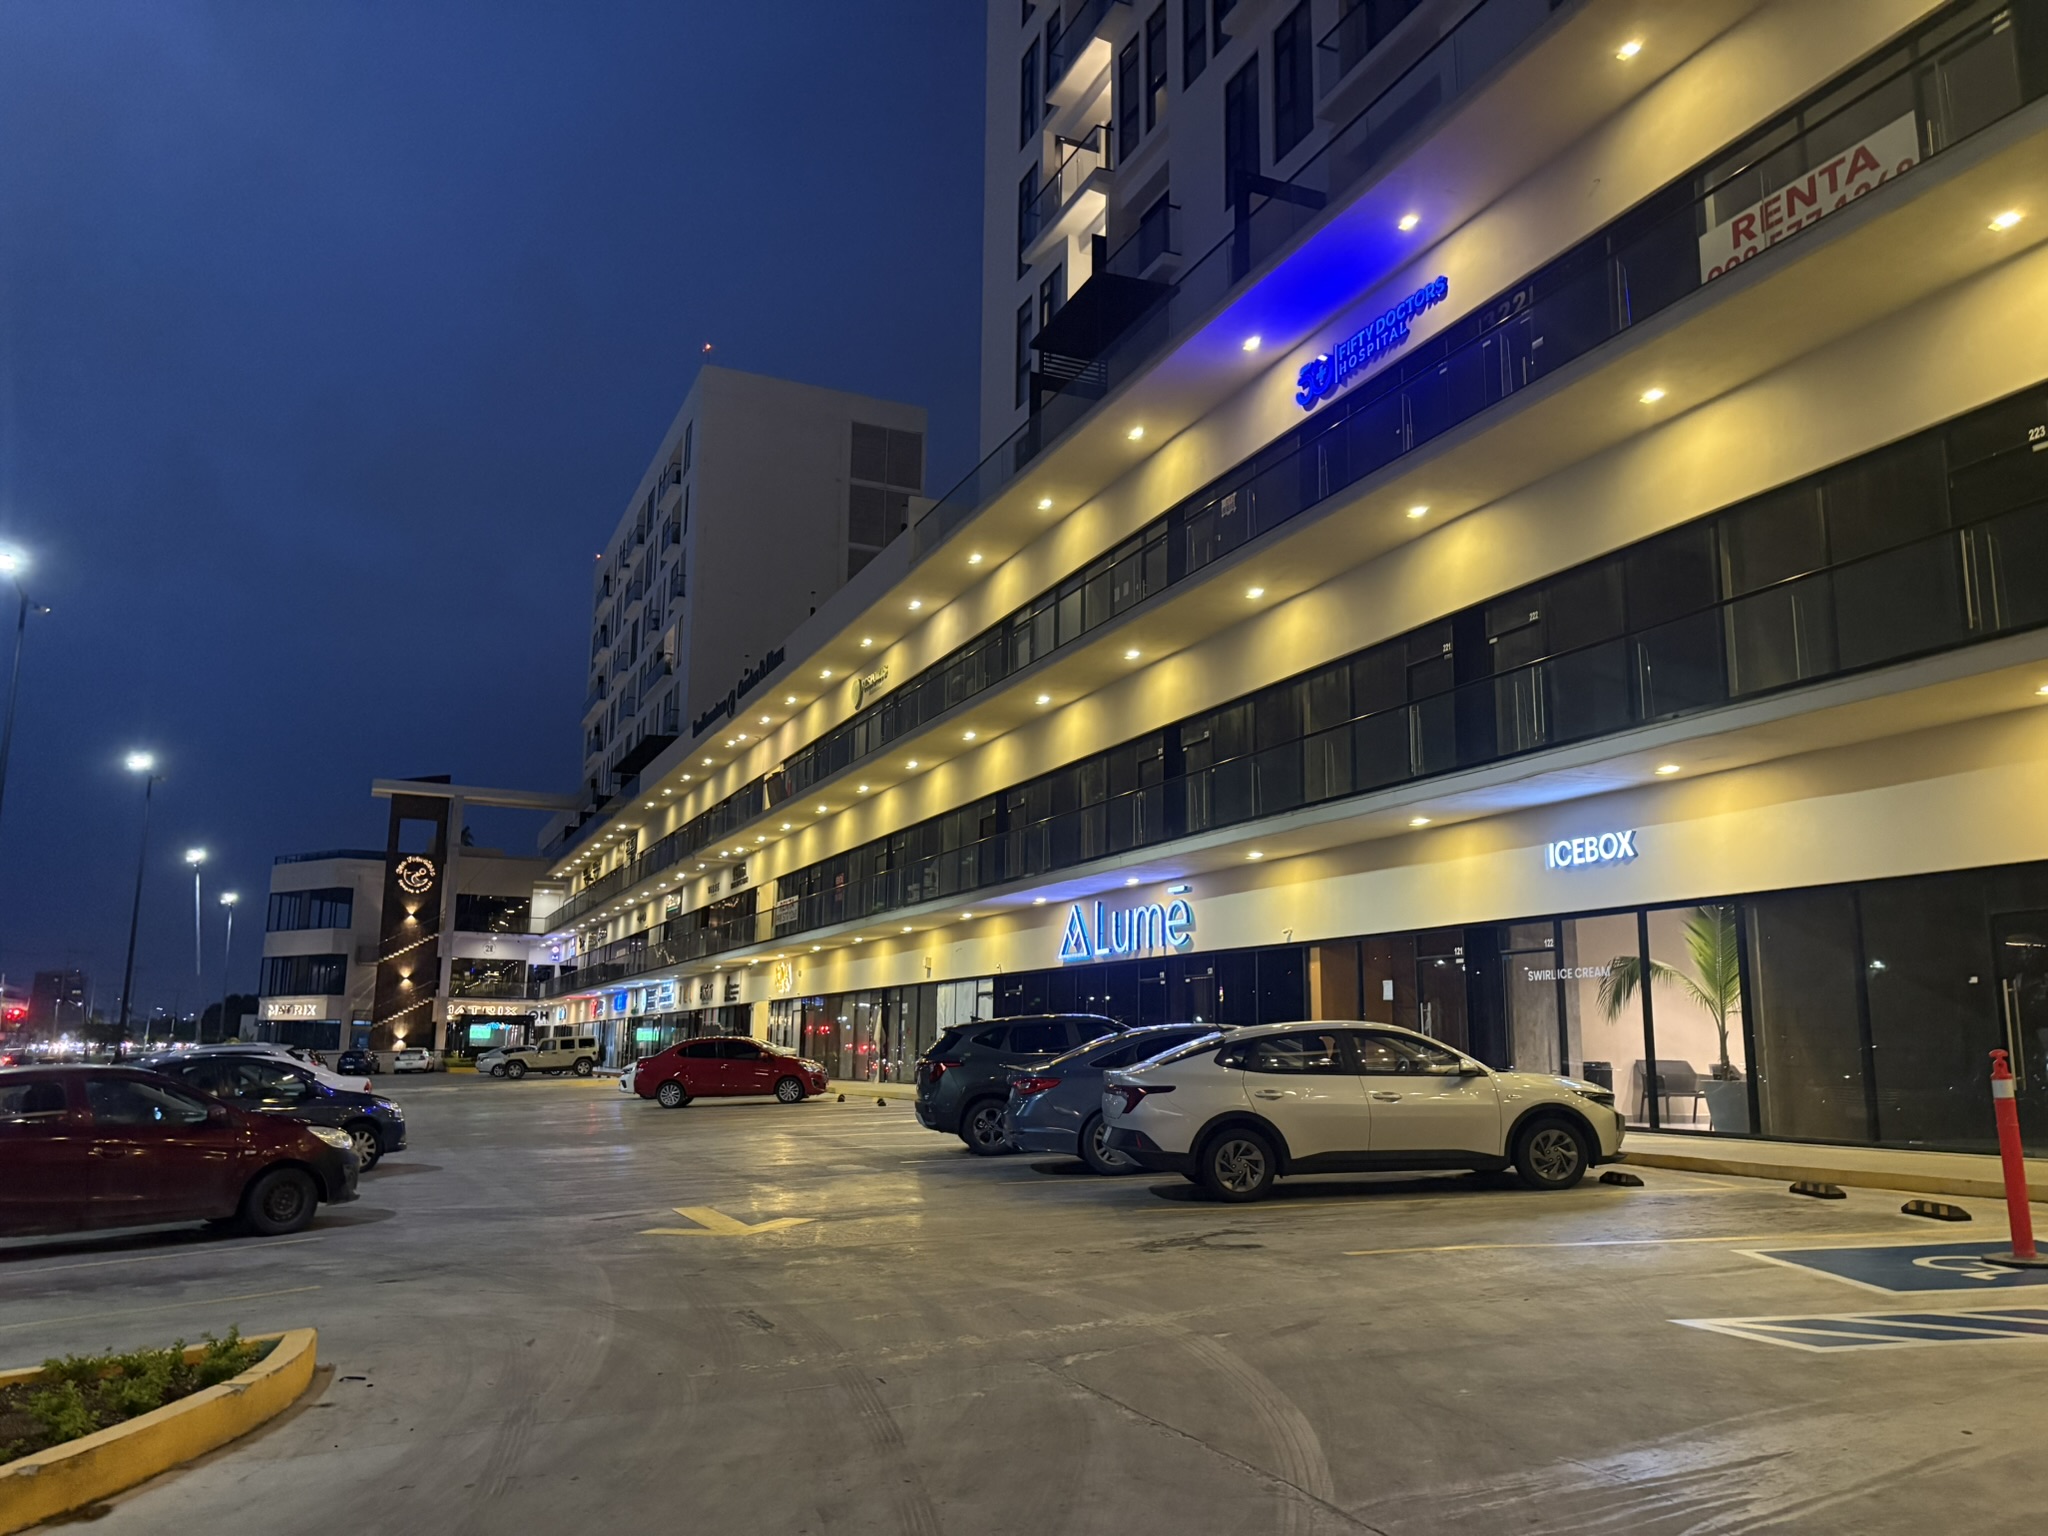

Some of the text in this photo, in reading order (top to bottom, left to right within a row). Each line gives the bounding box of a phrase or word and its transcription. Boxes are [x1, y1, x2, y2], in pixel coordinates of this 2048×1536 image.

[1732, 145, 1880, 250] RENTA
[1339, 275, 1448, 361] FIFTY DOCTORS
[1339, 321, 1408, 376] HOSPITAL
[2028, 425, 2046, 441] 223
[1548, 829, 1638, 868] ICEBOX
[1544, 938, 1554, 948] 122
[1528, 966, 1611, 981] SWIRL ICE CREAM
[268, 1004, 317, 1017] MATRIX
